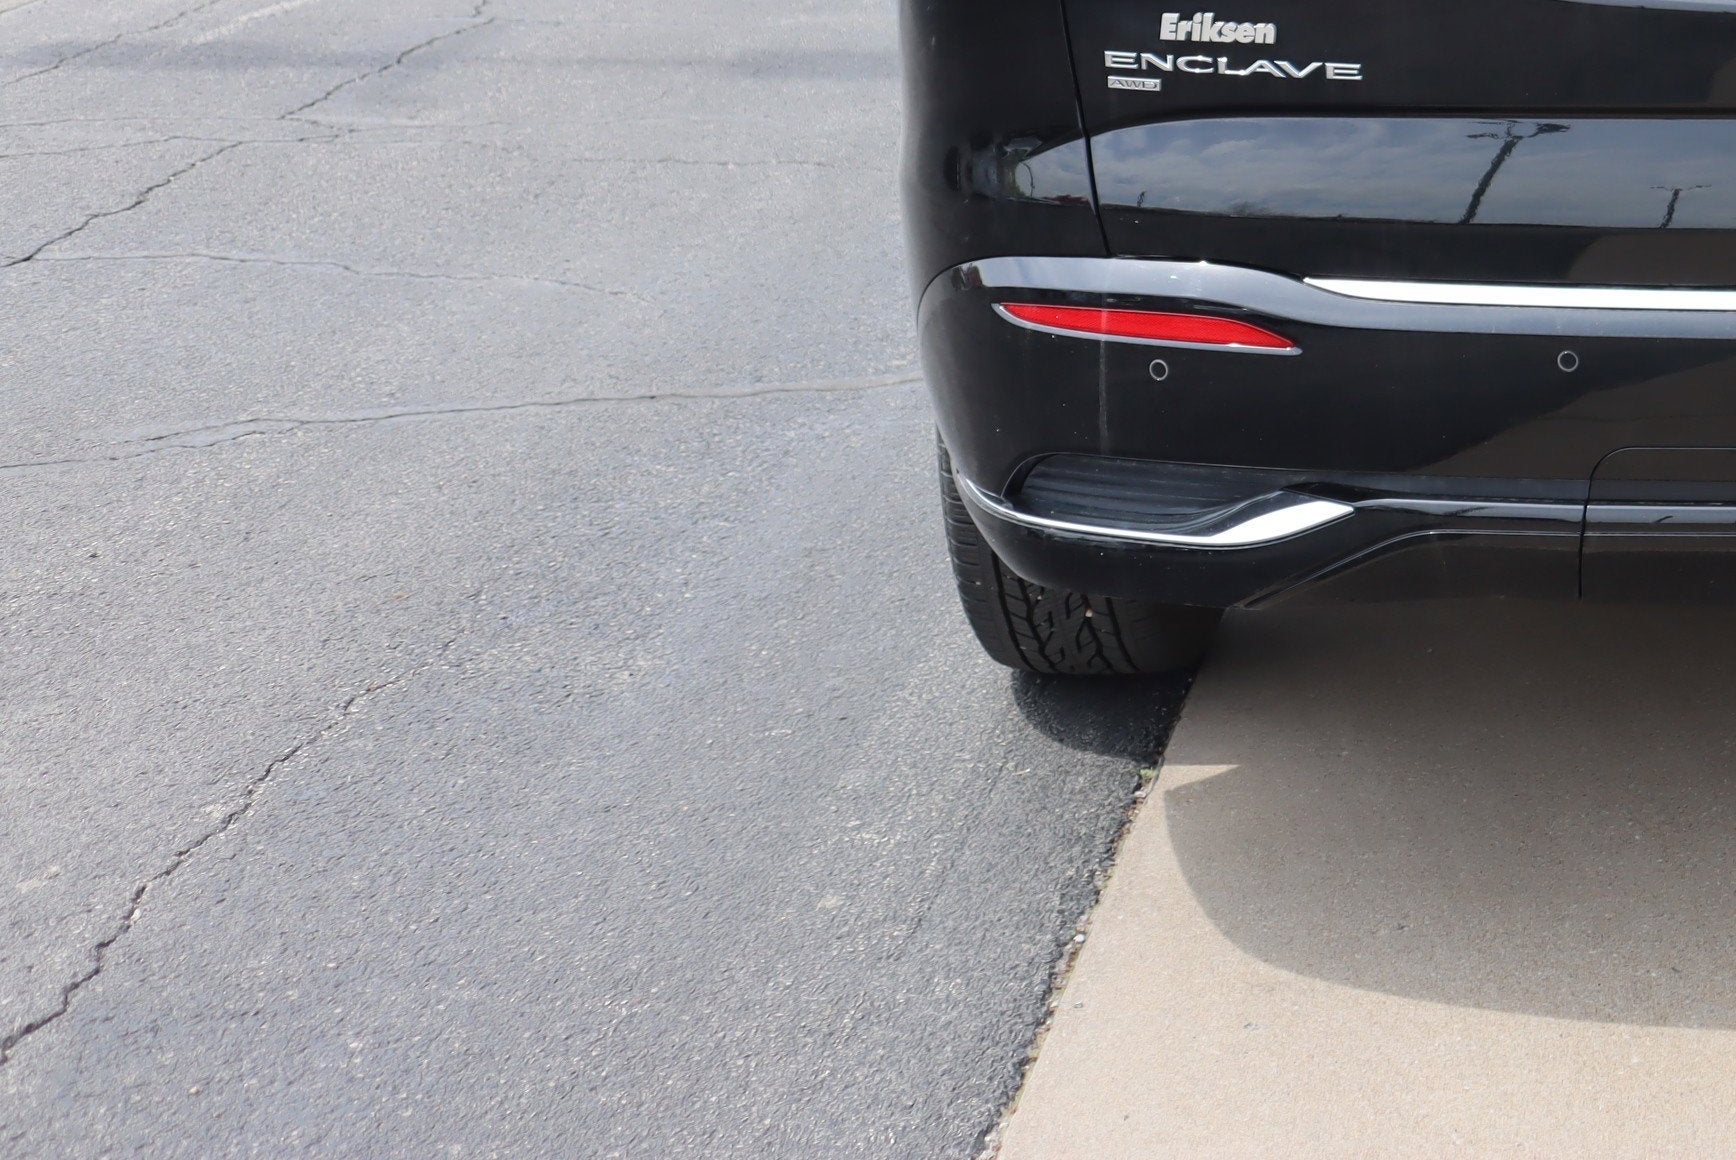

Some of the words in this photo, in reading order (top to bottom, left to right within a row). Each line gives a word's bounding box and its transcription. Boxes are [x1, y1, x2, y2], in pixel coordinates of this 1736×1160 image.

[1159, 12, 1278, 45] Eriksen
[1104, 50, 1363, 81] ENCLAVE
[1109, 77, 1160, 90] AWD
